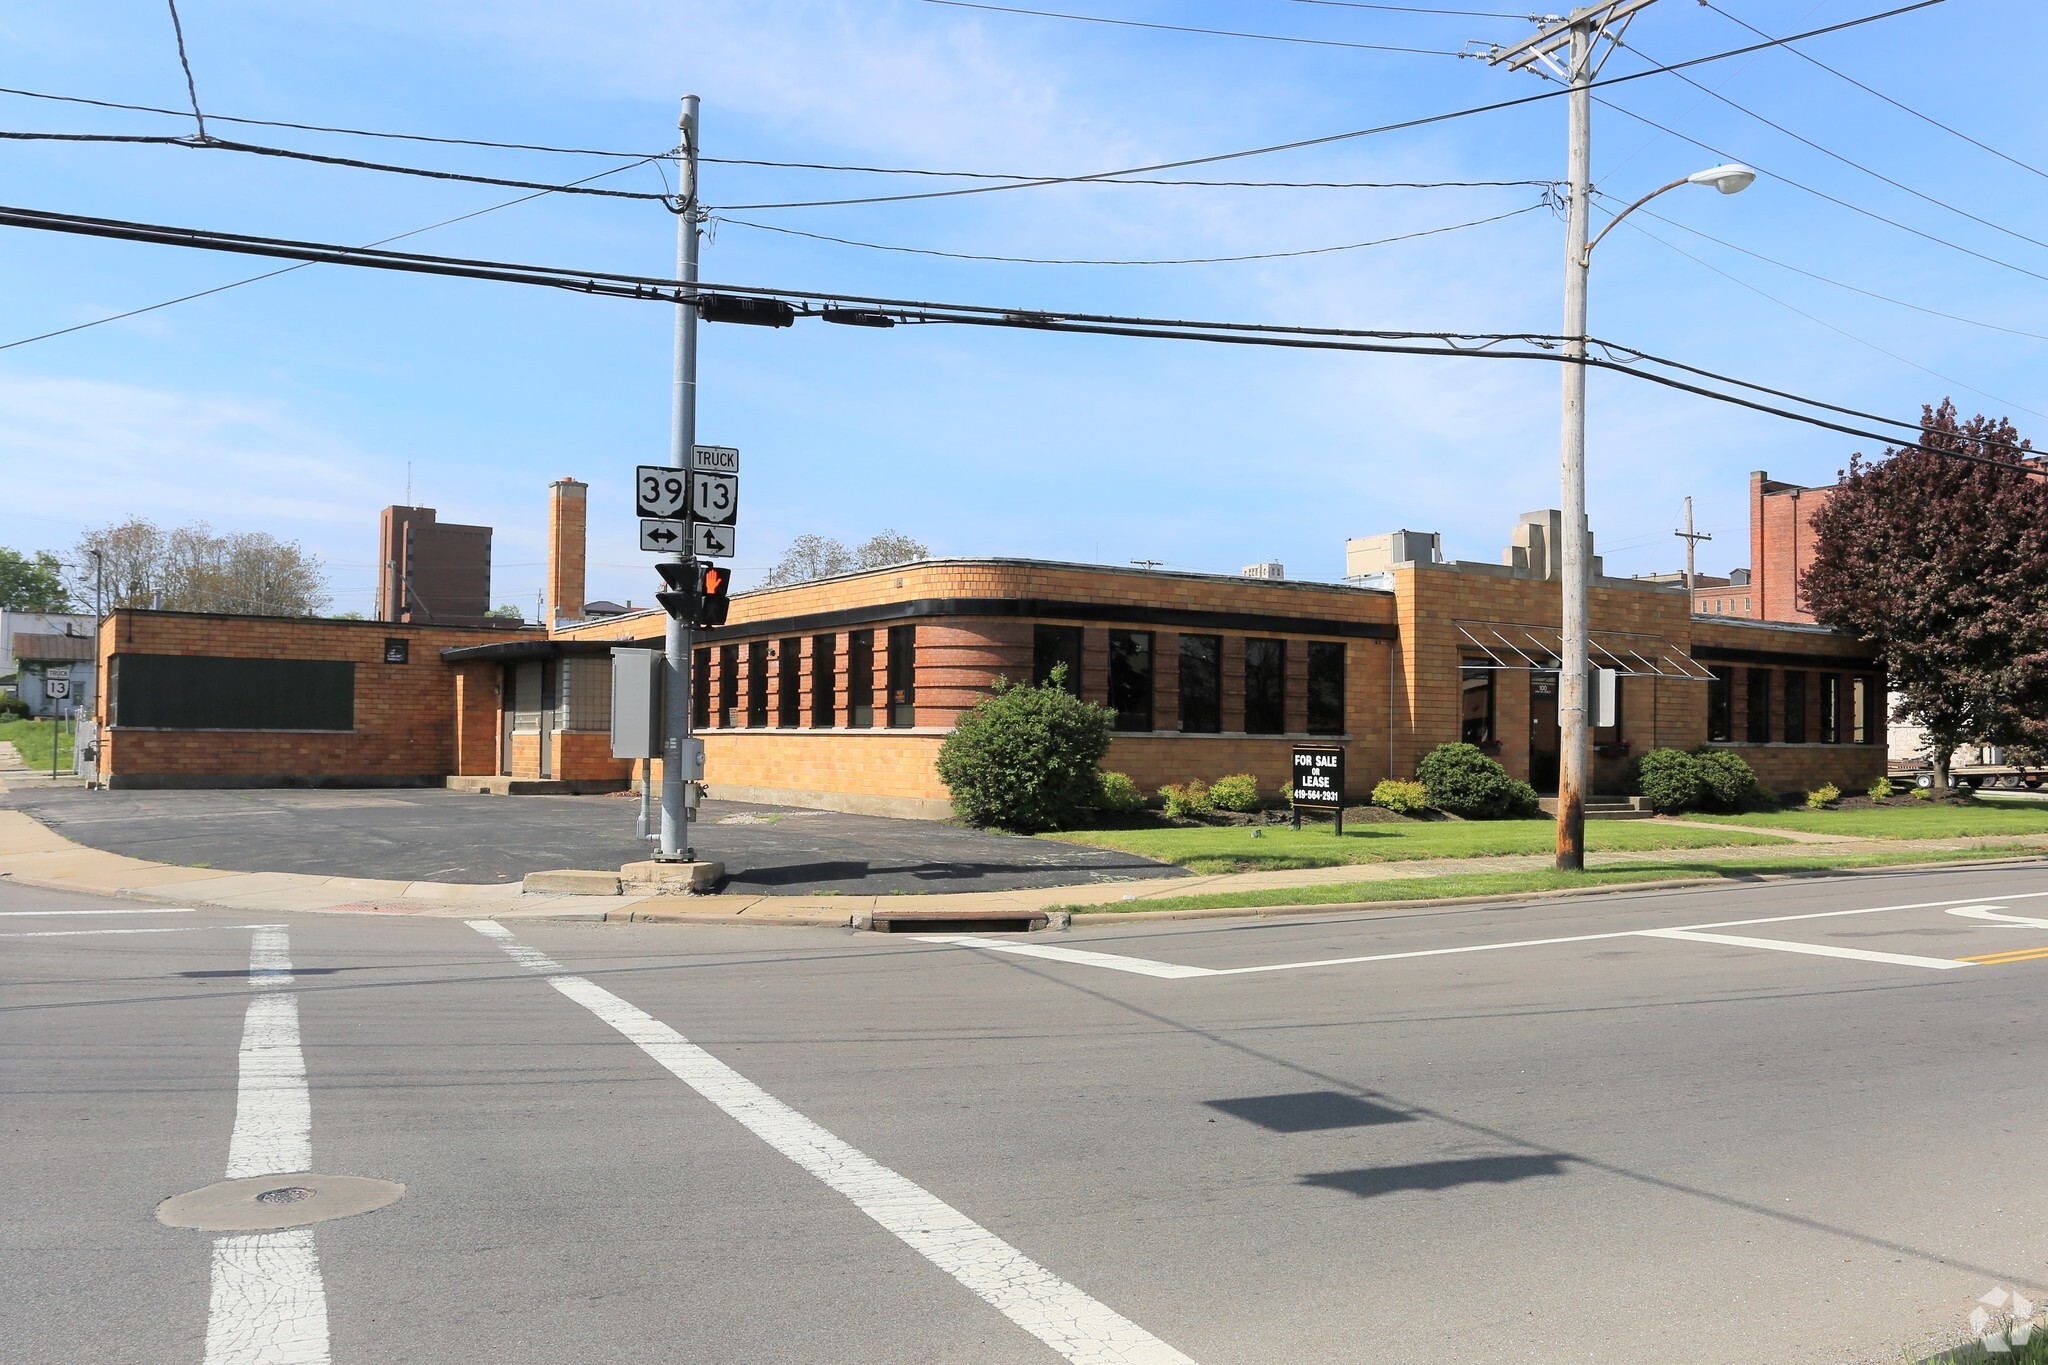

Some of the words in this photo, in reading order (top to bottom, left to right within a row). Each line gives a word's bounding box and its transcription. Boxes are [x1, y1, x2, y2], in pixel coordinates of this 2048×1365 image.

[696, 451, 735, 467] TRUCK
[642, 476, 682, 505] 39
[701, 482, 730, 510] 13
[51, 682, 66, 694] 13
[1294, 755, 1313, 766] FOR
[1315, 755, 1337, 767] SALE
[1311, 767, 1321, 776] OR
[1302, 776, 1330, 788] LEASE
[1294, 789, 1338, 801] 419-564-2931
